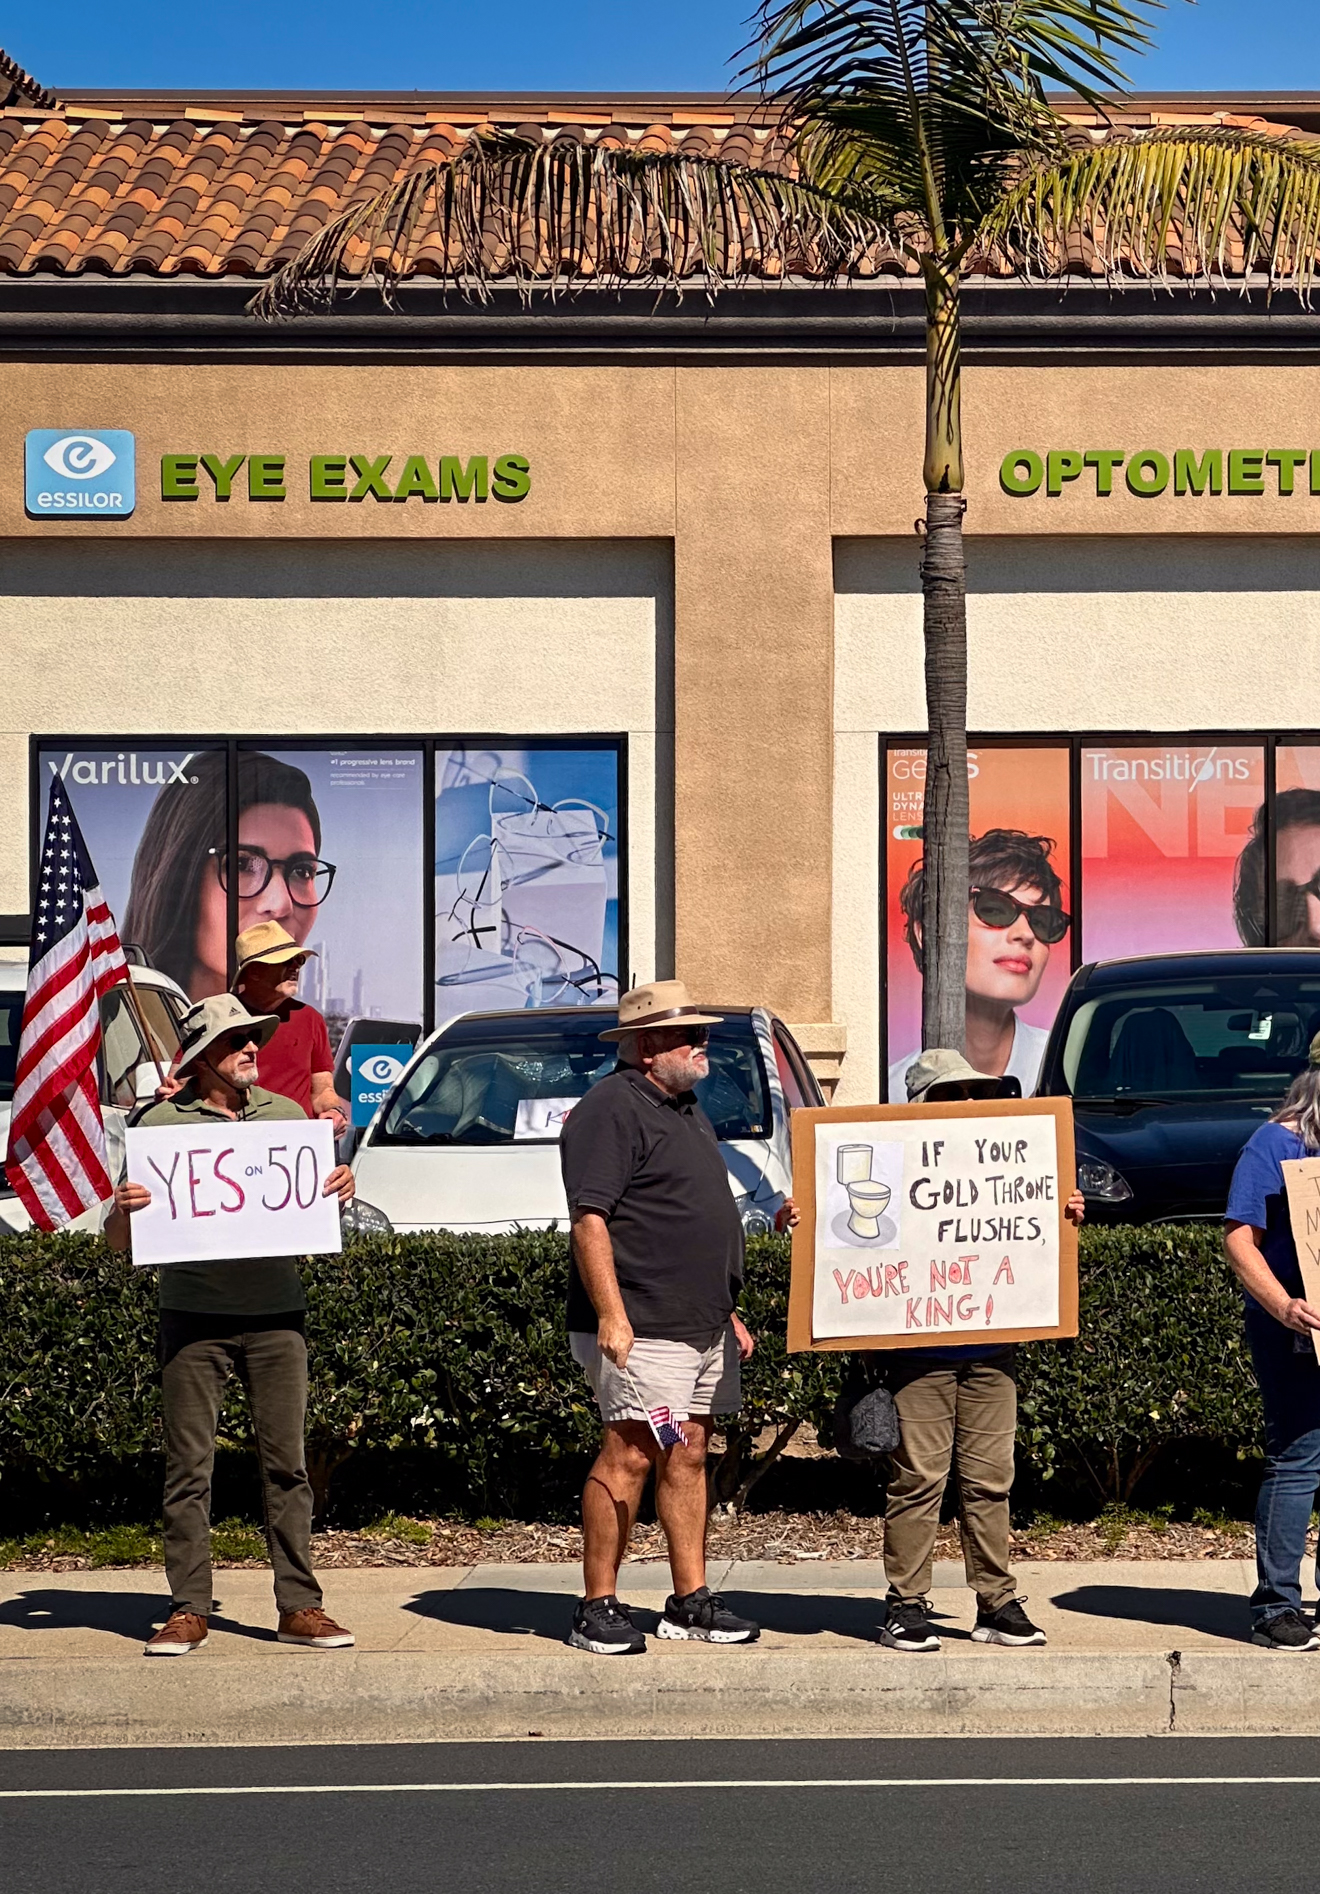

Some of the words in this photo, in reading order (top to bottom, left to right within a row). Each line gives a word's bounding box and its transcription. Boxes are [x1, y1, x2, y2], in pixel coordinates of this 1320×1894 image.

[161, 454, 287, 502] EYE
[310, 453, 531, 503] EXAMS
[340, 758, 378, 767] progressive
[395, 758, 416, 766] brand
[1086, 750, 1251, 788] Transitions
[892, 791, 923, 801] ULTR
[922, 1140, 945, 1167] IF
[974, 1138, 1029, 1164] YOUR
[147, 1147, 246, 1220] YES
[244, 1165, 264, 1177] ON
[262, 1145, 319, 1212] 50
[909, 1177, 979, 1210] GOLD
[985, 1175, 1054, 1206] THRONE
[832, 1260, 911, 1305] YOU'RE
[929, 1254, 980, 1293] NOT
[992, 1255, 1015, 1286] A
[905, 1293, 994, 1329] KING!
